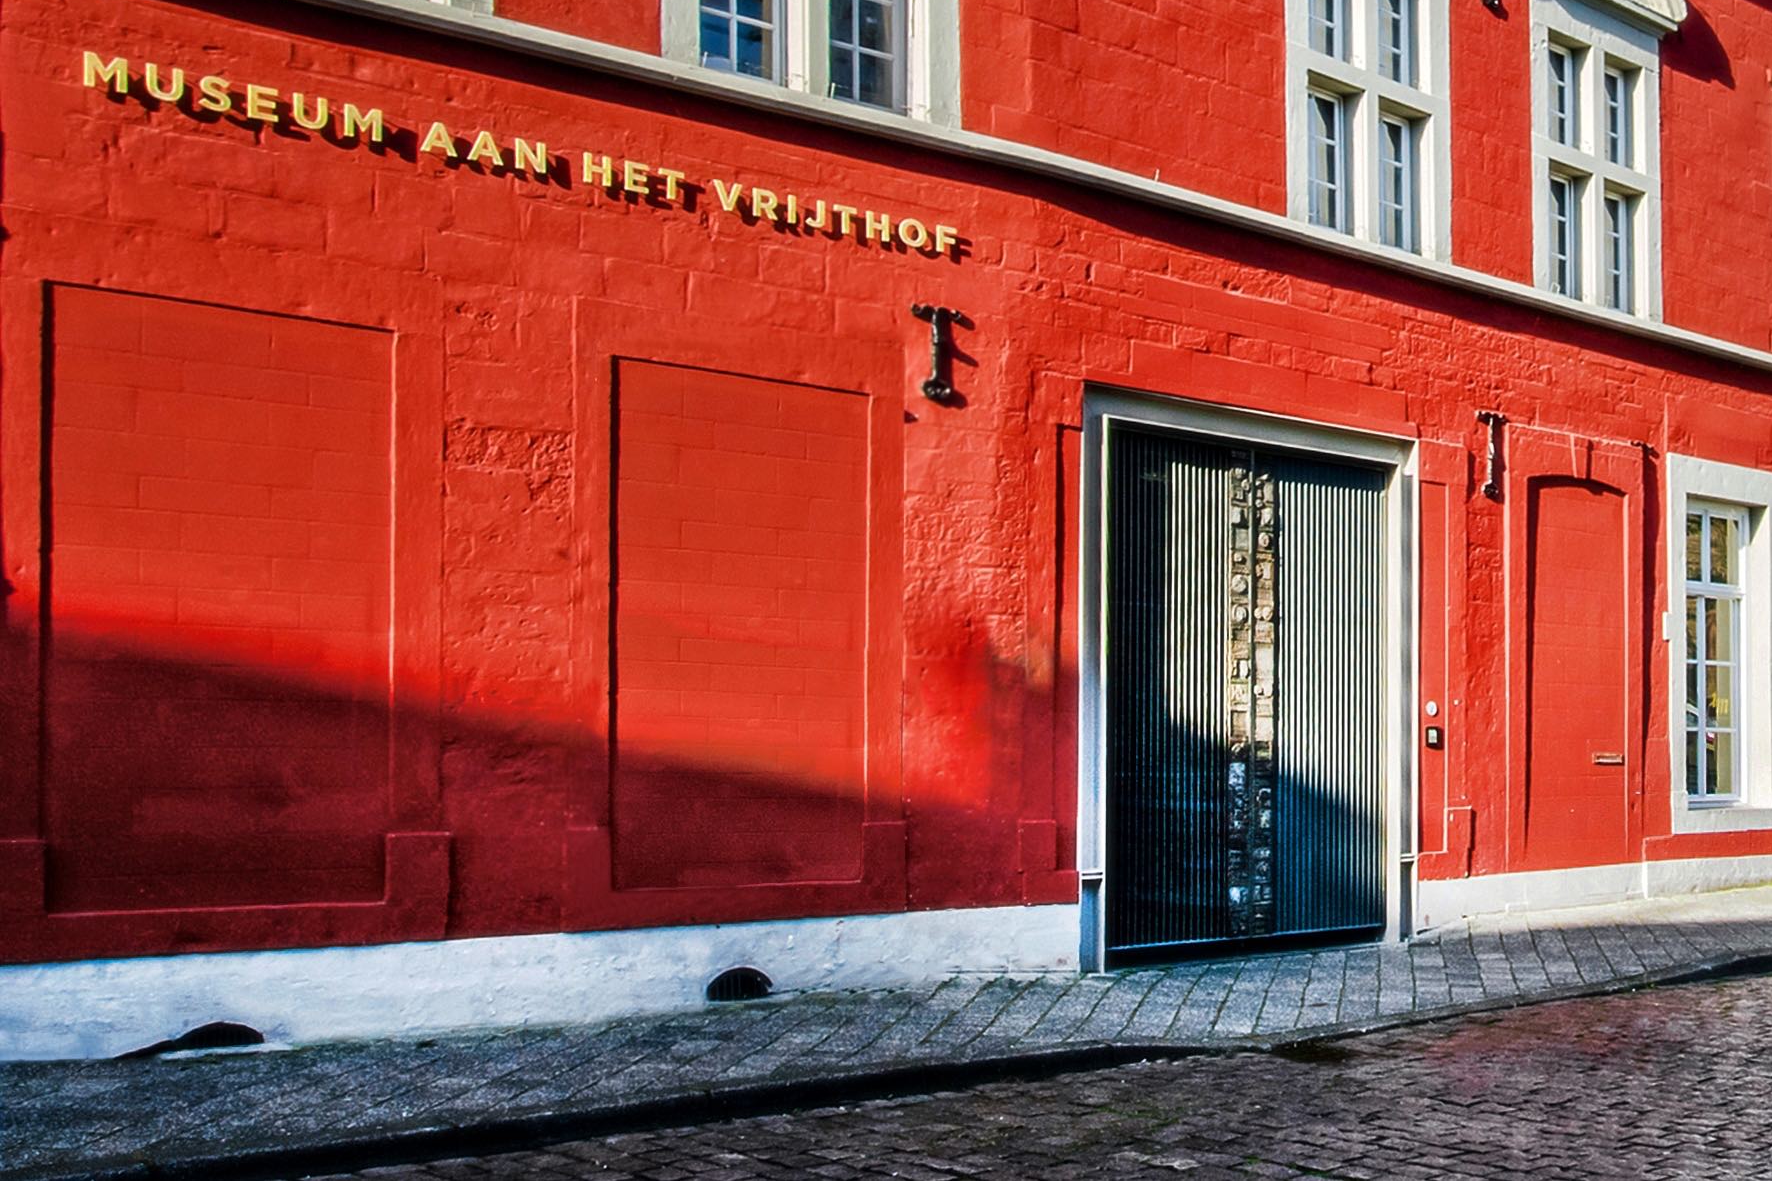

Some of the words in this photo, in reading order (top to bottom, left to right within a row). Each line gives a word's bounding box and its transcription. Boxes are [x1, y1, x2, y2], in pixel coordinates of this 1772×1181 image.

[83, 51, 383, 142] MUSEUM
[420, 122, 547, 174] AAN
[583, 152, 685, 199] HET
[713, 179, 957, 252] VRIJTHOF
